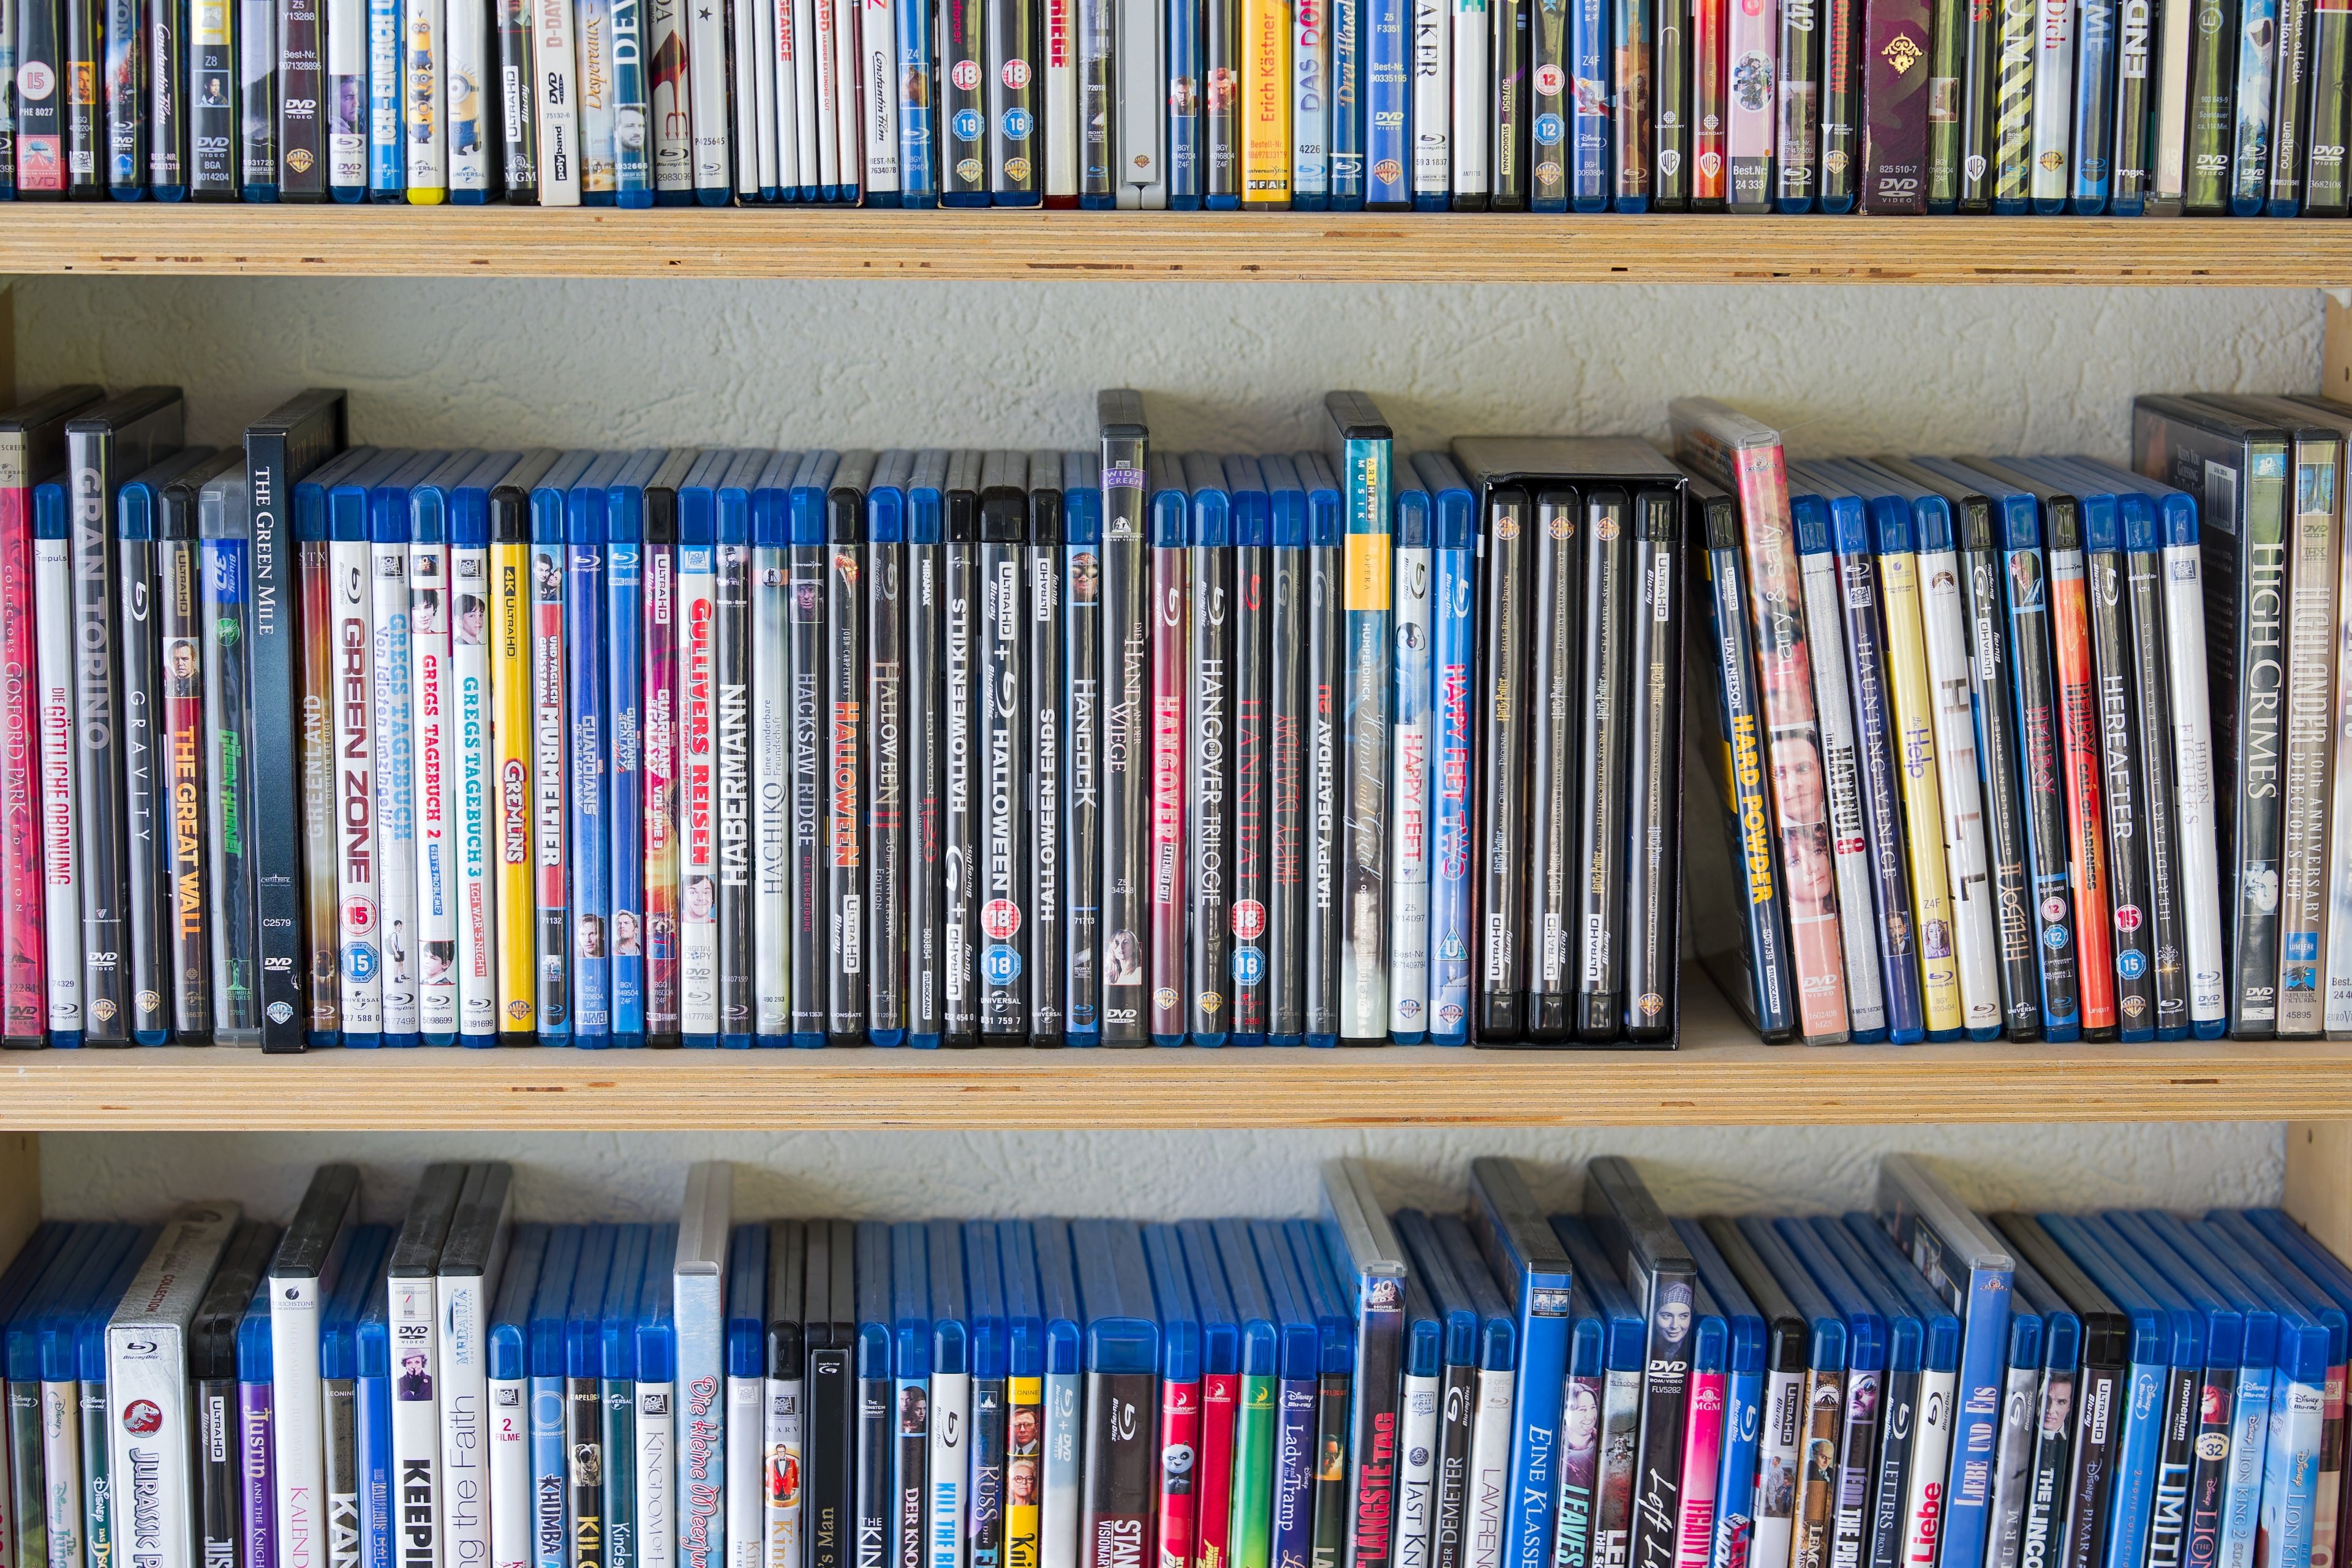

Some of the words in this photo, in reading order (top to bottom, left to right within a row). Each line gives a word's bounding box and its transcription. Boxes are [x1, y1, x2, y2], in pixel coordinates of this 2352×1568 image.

[283, 12, 315, 21] Y13288
[1261, 13, 1275, 77] Kästner
[28, 73, 43, 88] 15
[155, 23, 170, 90] Constantin
[206, 56, 217, 66] Z8
[283, 50, 317, 59] Best-Nr.
[584, 20, 603, 111] Despereaux
[959, 68, 977, 83] 18
[1371, 74, 1406, 83] 90335195
[1374, 62, 1404, 71] Best-Nr.
[1543, 74, 1556, 85] 12
[1583, 56, 1600, 66] Z4F
[19, 108, 34, 117] PHE
[36, 108, 53, 117] 8027
[159, 93, 170, 125] Film
[286, 99, 316, 109] DVD
[962, 119, 975, 130] 18
[1261, 82, 1273, 122] Erich
[1541, 123, 1556, 135] 12
[197, 137, 228, 146] DVD
[556, 126, 566, 180] polyband
[696, 137, 725, 146] P425645
[1299, 145, 1320, 154] 4226
[1733, 165, 1766, 176] Best.Nr:
[2281, 122, 2291, 169] weltkino
[505, 172, 537, 182] MGM
[658, 173, 691, 181] 2983099
[1736, 180, 1745, 189] 24
[1748, 180, 1763, 189] 333
[1880, 179, 1918, 190] DVD
[255, 469, 270, 506] THE
[1366, 460, 1376, 519] ARTHAUS
[74, 467, 106, 589] GRAN
[257, 513, 273, 578] GREEN
[4, 566, 17, 653] COLLECTOR'S
[258, 585, 274, 635] MILE
[922, 560, 930, 605] MIRAMAX
[2252, 541, 2283, 646] HIGH
[540, 637, 548, 679] GRÜSST
[952, 598, 967, 662] KILLS
[1724, 637, 1737, 663] LIAM
[77, 596, 110, 749] TORINO
[341, 618, 367, 762] GREEN
[423, 655, 438, 715] GREGS
[549, 659, 559, 704] TÄGLICH
[690, 598, 710, 756] GULLIVERS
[1362, 624, 1371, 701] HUMPERDINCK
[1727, 666, 1742, 708] NEESON
[2291, 585, 2331, 744] HIGHLANDER
[4, 662, 26, 762] GOSFORD
[51, 688, 65, 703] DIE
[462, 676, 481, 748] GREGS
[540, 682, 548, 703] DAS
[1319, 685, 1333, 714] 2U
[1444, 663, 1468, 742] HAPPY
[44, 706, 73, 797] GÖTTLICHE
[175, 727, 195, 777] THE
[796, 673, 816, 777] HACKSAW
[953, 670, 967, 812] HALLOWEEN
[1041, 709, 1054, 770] ENDS
[1074, 679, 1096, 808] HANCOCK
[1733, 714, 1758, 787] HARD
[1912, 717, 1923, 729] the
[2249, 659, 2281, 798] CRIMES
[130, 691, 150, 842] GRAVITY
[424, 724, 440, 820] TAGEBUCH
[1155, 695, 1180, 838] HANGOVER
[1317, 719, 1332, 830] DEATHDAY
[1402, 734, 1422, 802] HAPPY
[1443, 748, 1468, 804] FEET
[1857, 643, 1885, 774] HAUNTING
[1872, 790, 1897, 879] VENICE
[1904, 729, 1931, 778] Help
[2103, 675, 2131, 839] HEREAFTER
[2309, 752, 2325, 788] 10th
[9, 767, 29, 815] PARK
[464, 753, 483, 862] TAGEBUCH
[540, 707, 562, 865] MURMELTIER
[721, 684, 748, 886] HABERMANN
[832, 701, 859, 866] HALLOWEEN
[990, 729, 1009, 890] HALLOWEEN
[1828, 745, 1860, 837] HATEFUL
[2287, 753, 2304, 858] DIRECTOR'S
[176, 782, 198, 867] GREAT
[343, 770, 369, 881] ZONE
[691, 765, 710, 864] REISEN
[797, 782, 816, 845] RIDGE
[1403, 809, 1422, 862] FEET
[12, 824, 23, 912] EDITION
[47, 804, 71, 885] ORDNUNG
[467, 866, 482, 876] 3
[1041, 780, 1054, 921] HALLOWEEN
[1161, 845, 1172, 885] EXTENDED
[1201, 816, 1221, 905] TRILOGIE
[1317, 832, 1330, 907] HAPPY
[1443, 810, 1468, 878] TWO
[1743, 796, 1773, 903] POWDER
[1835, 839, 1865, 854] 8
[2305, 796, 2323, 922] ANNIVERSARY
[178, 873, 201, 940] WALL
[1158, 886, 1170, 901] CUT
[2286, 866, 2302, 899] CUT
[263, 918, 291, 927] C2579
[350, 907, 367, 924] 15
[922, 928, 932, 959] 503854
[347, 954, 368, 971] 15
[689, 1376, 717, 1415] Die
[2177, 1379, 2192, 1441] momentum
[449, 1396, 476, 1468] Faith
[690, 1420, 717, 1478] kleine
[1281, 1424, 1303, 1466] Lady
[1529, 1424, 1553, 1482] EINE
[2206, 1444, 2224, 1456] 32
[2238, 1447, 2255, 1483] LION
[130, 1449, 160, 1548] JURASSIC
[452, 1480, 477, 1530] the
[536, 1473, 562, 1555] KHUMBA
[935, 1482, 956, 1515] KILL
[1280, 1475, 1300, 1530] Tramp
[1441, 1457, 1463, 1544] DEMETER
[1879, 1460, 1900, 1529] LETTERS
[1912, 1482, 1942, 1562] Liebe
[2234, 1488, 2250, 1525] KING
[935, 1519, 956, 1547] THE
[1555, 1483, 1589, 1567] LEAVES
[1876, 1532, 1886, 1555] FROM
